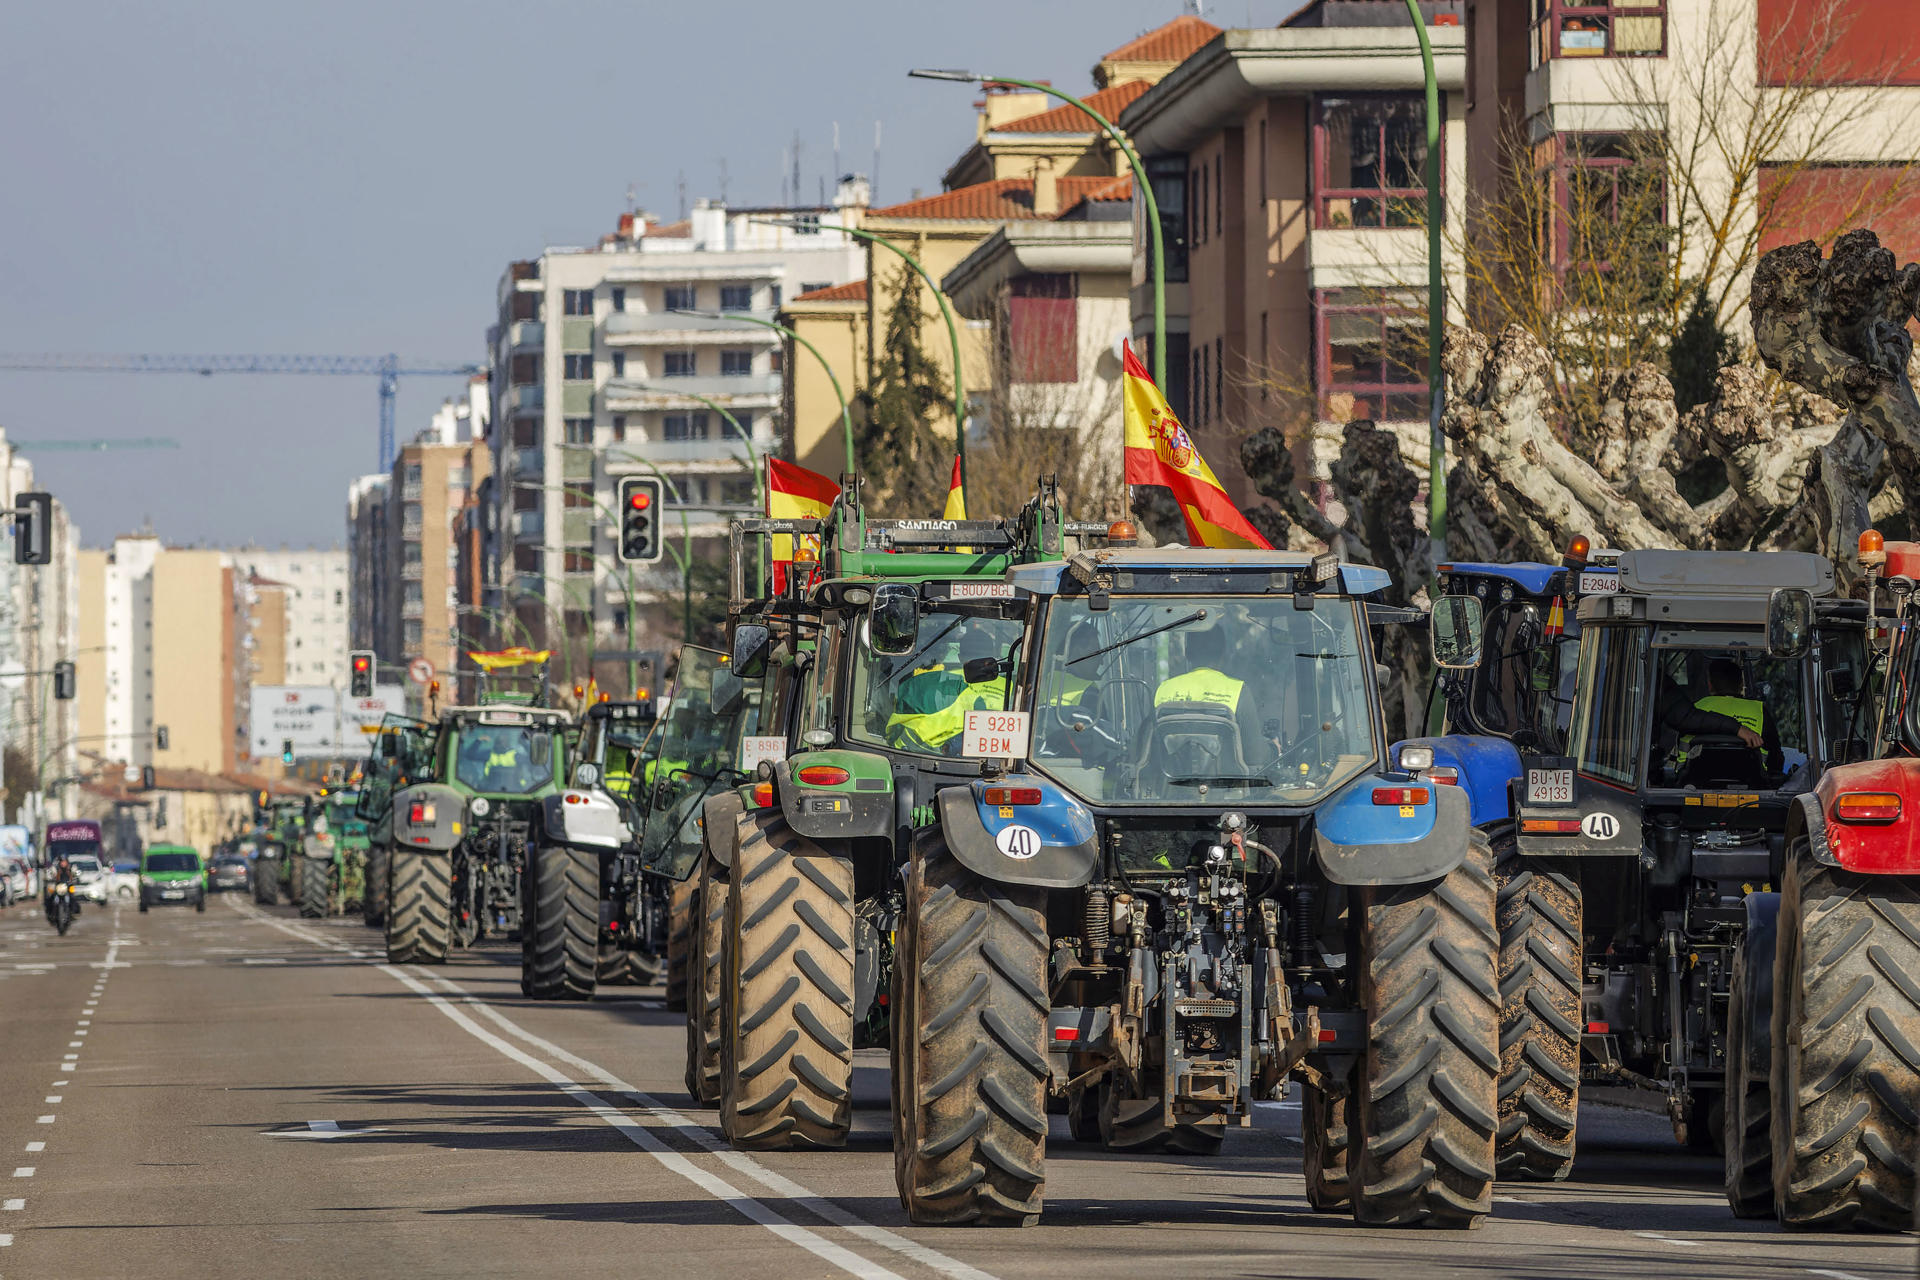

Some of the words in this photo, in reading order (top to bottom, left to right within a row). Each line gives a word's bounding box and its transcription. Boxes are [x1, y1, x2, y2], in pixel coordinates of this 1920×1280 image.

[898, 520, 957, 530] SANTIAGO
[968, 715, 978, 731] E
[987, 716, 1022, 733] 9281
[978, 737, 1011, 753] BBM
[1534, 786, 1568, 800] 49133
[1589, 816, 1613, 838] 40
[1007, 829, 1032, 856] 40
